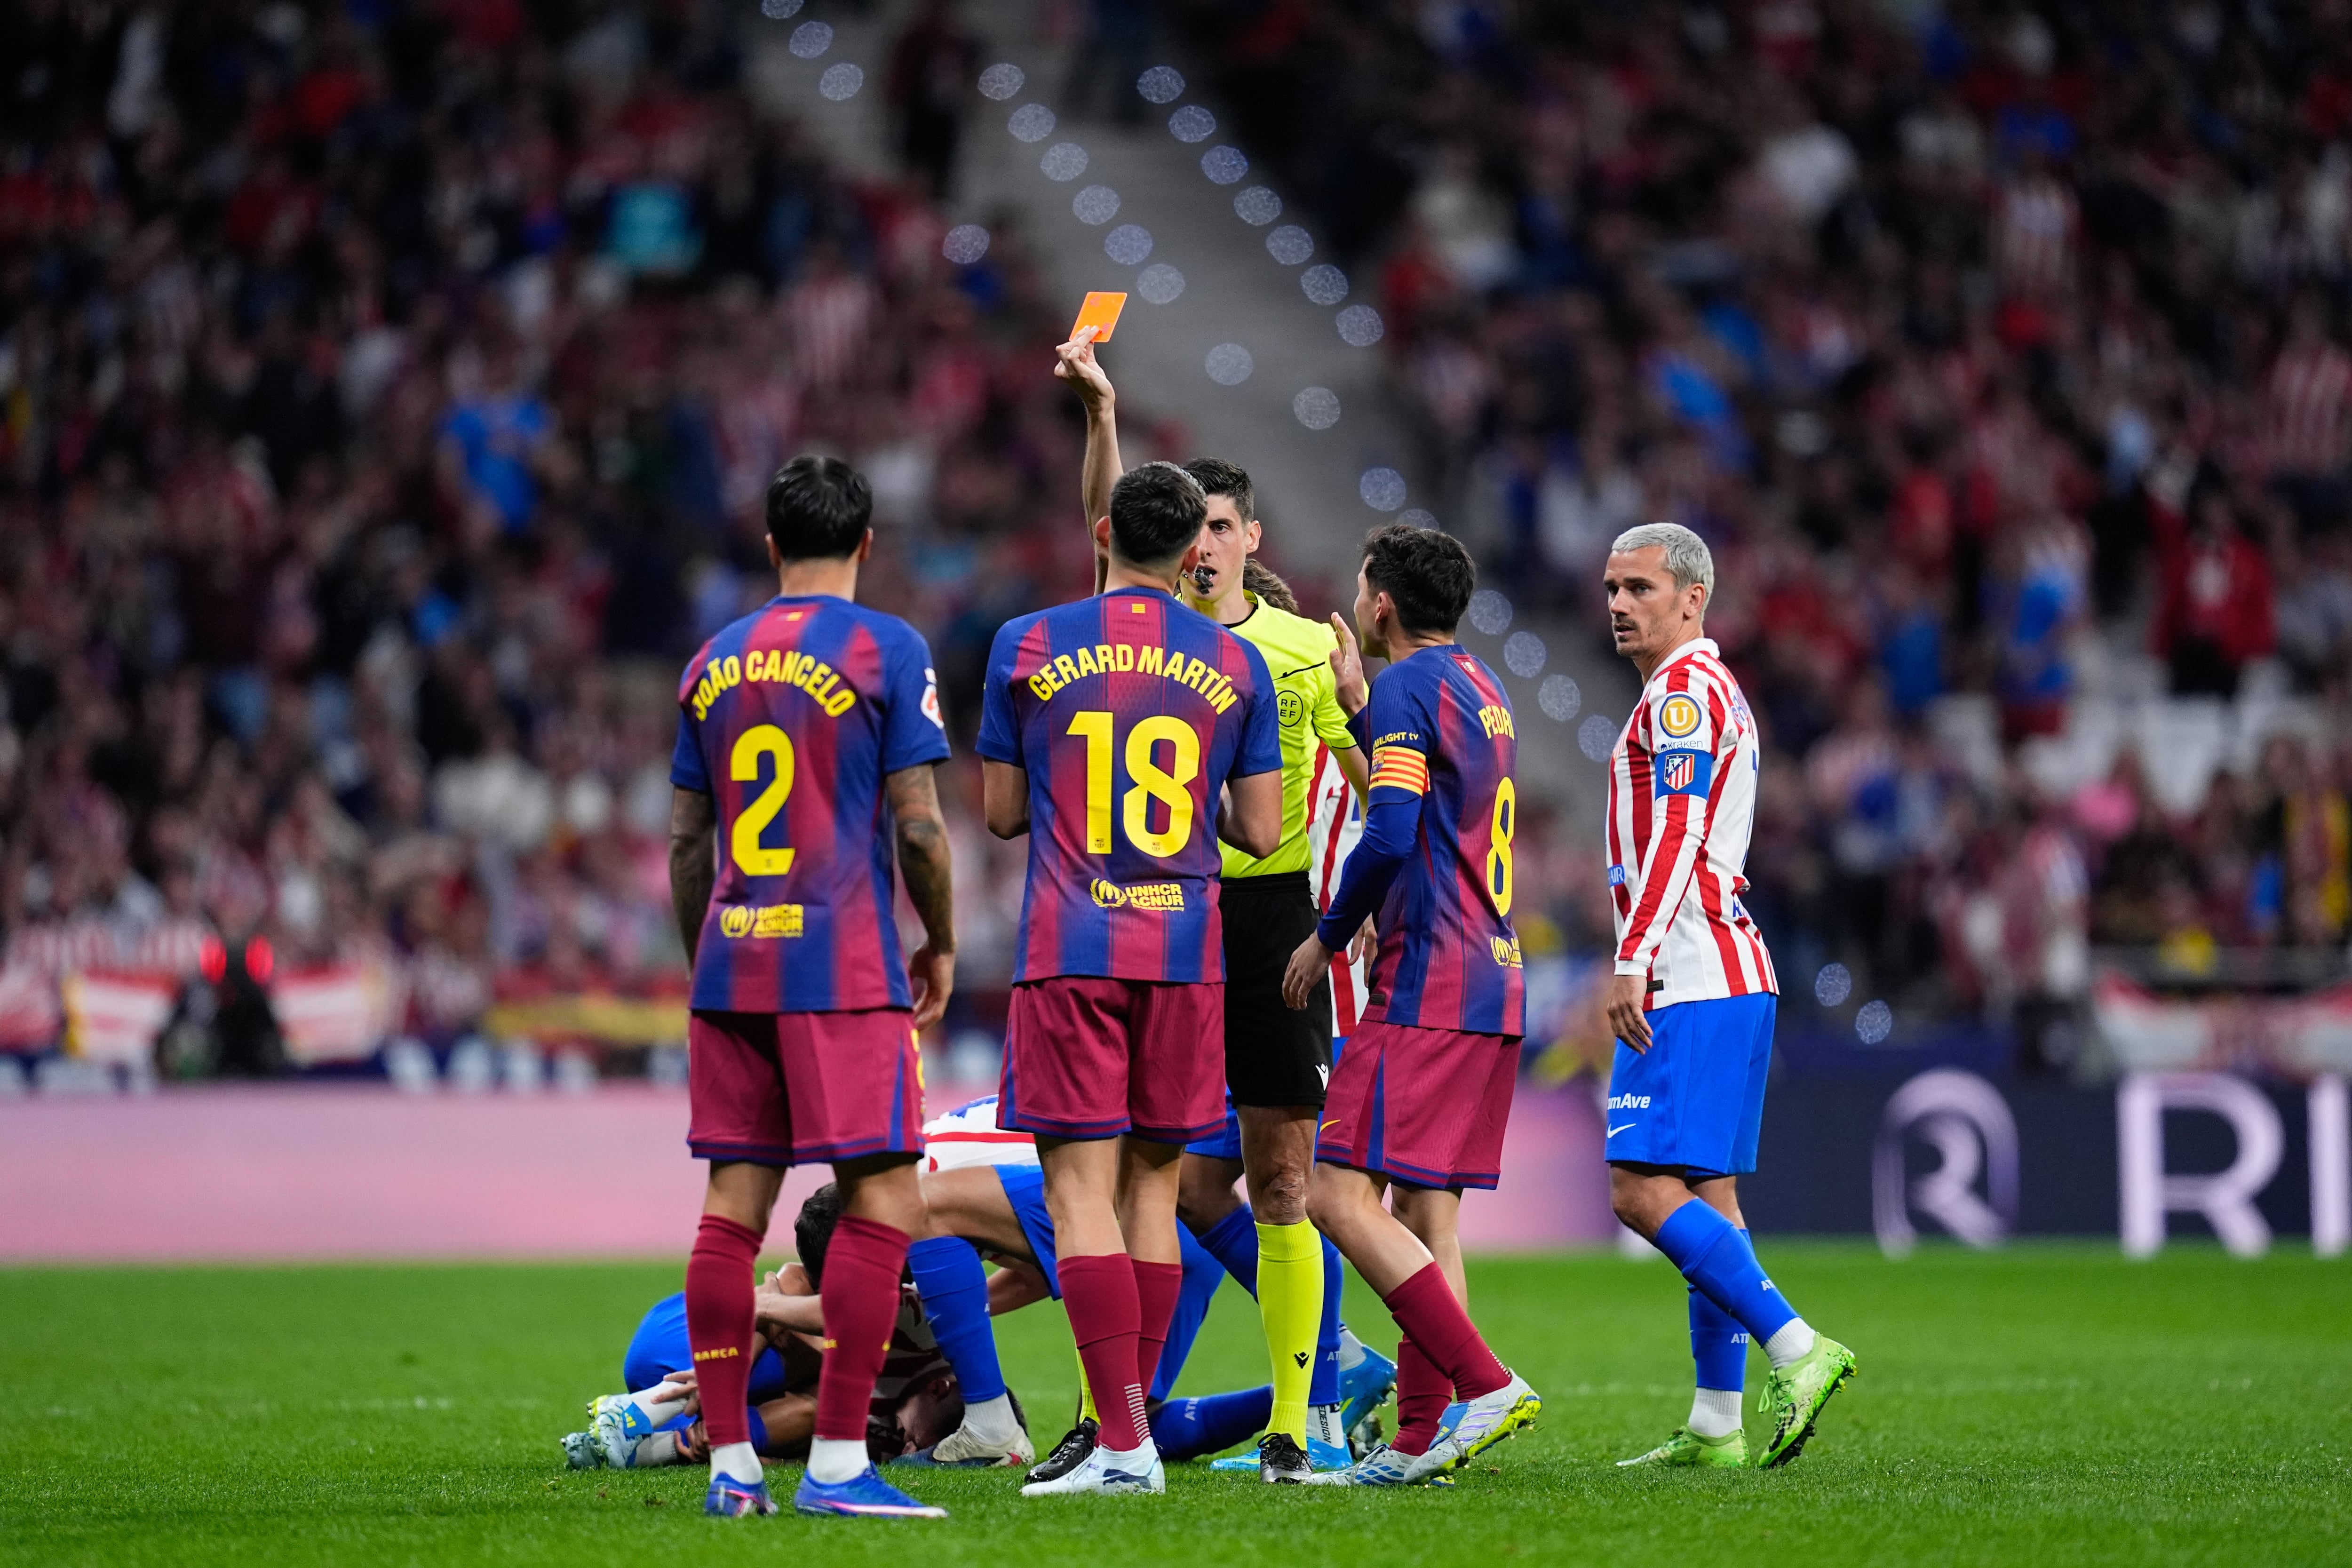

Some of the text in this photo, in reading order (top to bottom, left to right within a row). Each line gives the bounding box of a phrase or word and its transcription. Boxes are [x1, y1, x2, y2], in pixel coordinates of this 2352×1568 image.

[691, 650, 857, 721] JOÃO CANCELO
[1028, 644, 1238, 715] GERARD MARTÍN
[1280, 709, 1296, 718] EF
[1281, 699, 1297, 708] RF
[1668, 707, 1689, 727] U
[1478, 705, 1514, 741] PEDRI
[1668, 740, 1703, 749] kraken
[1065, 710, 1200, 858] 18
[730, 723, 796, 876] 2
[1486, 776, 1516, 917] 8
[1125, 883, 1182, 897] UNHCR
[1130, 895, 1184, 907] ACNUR
